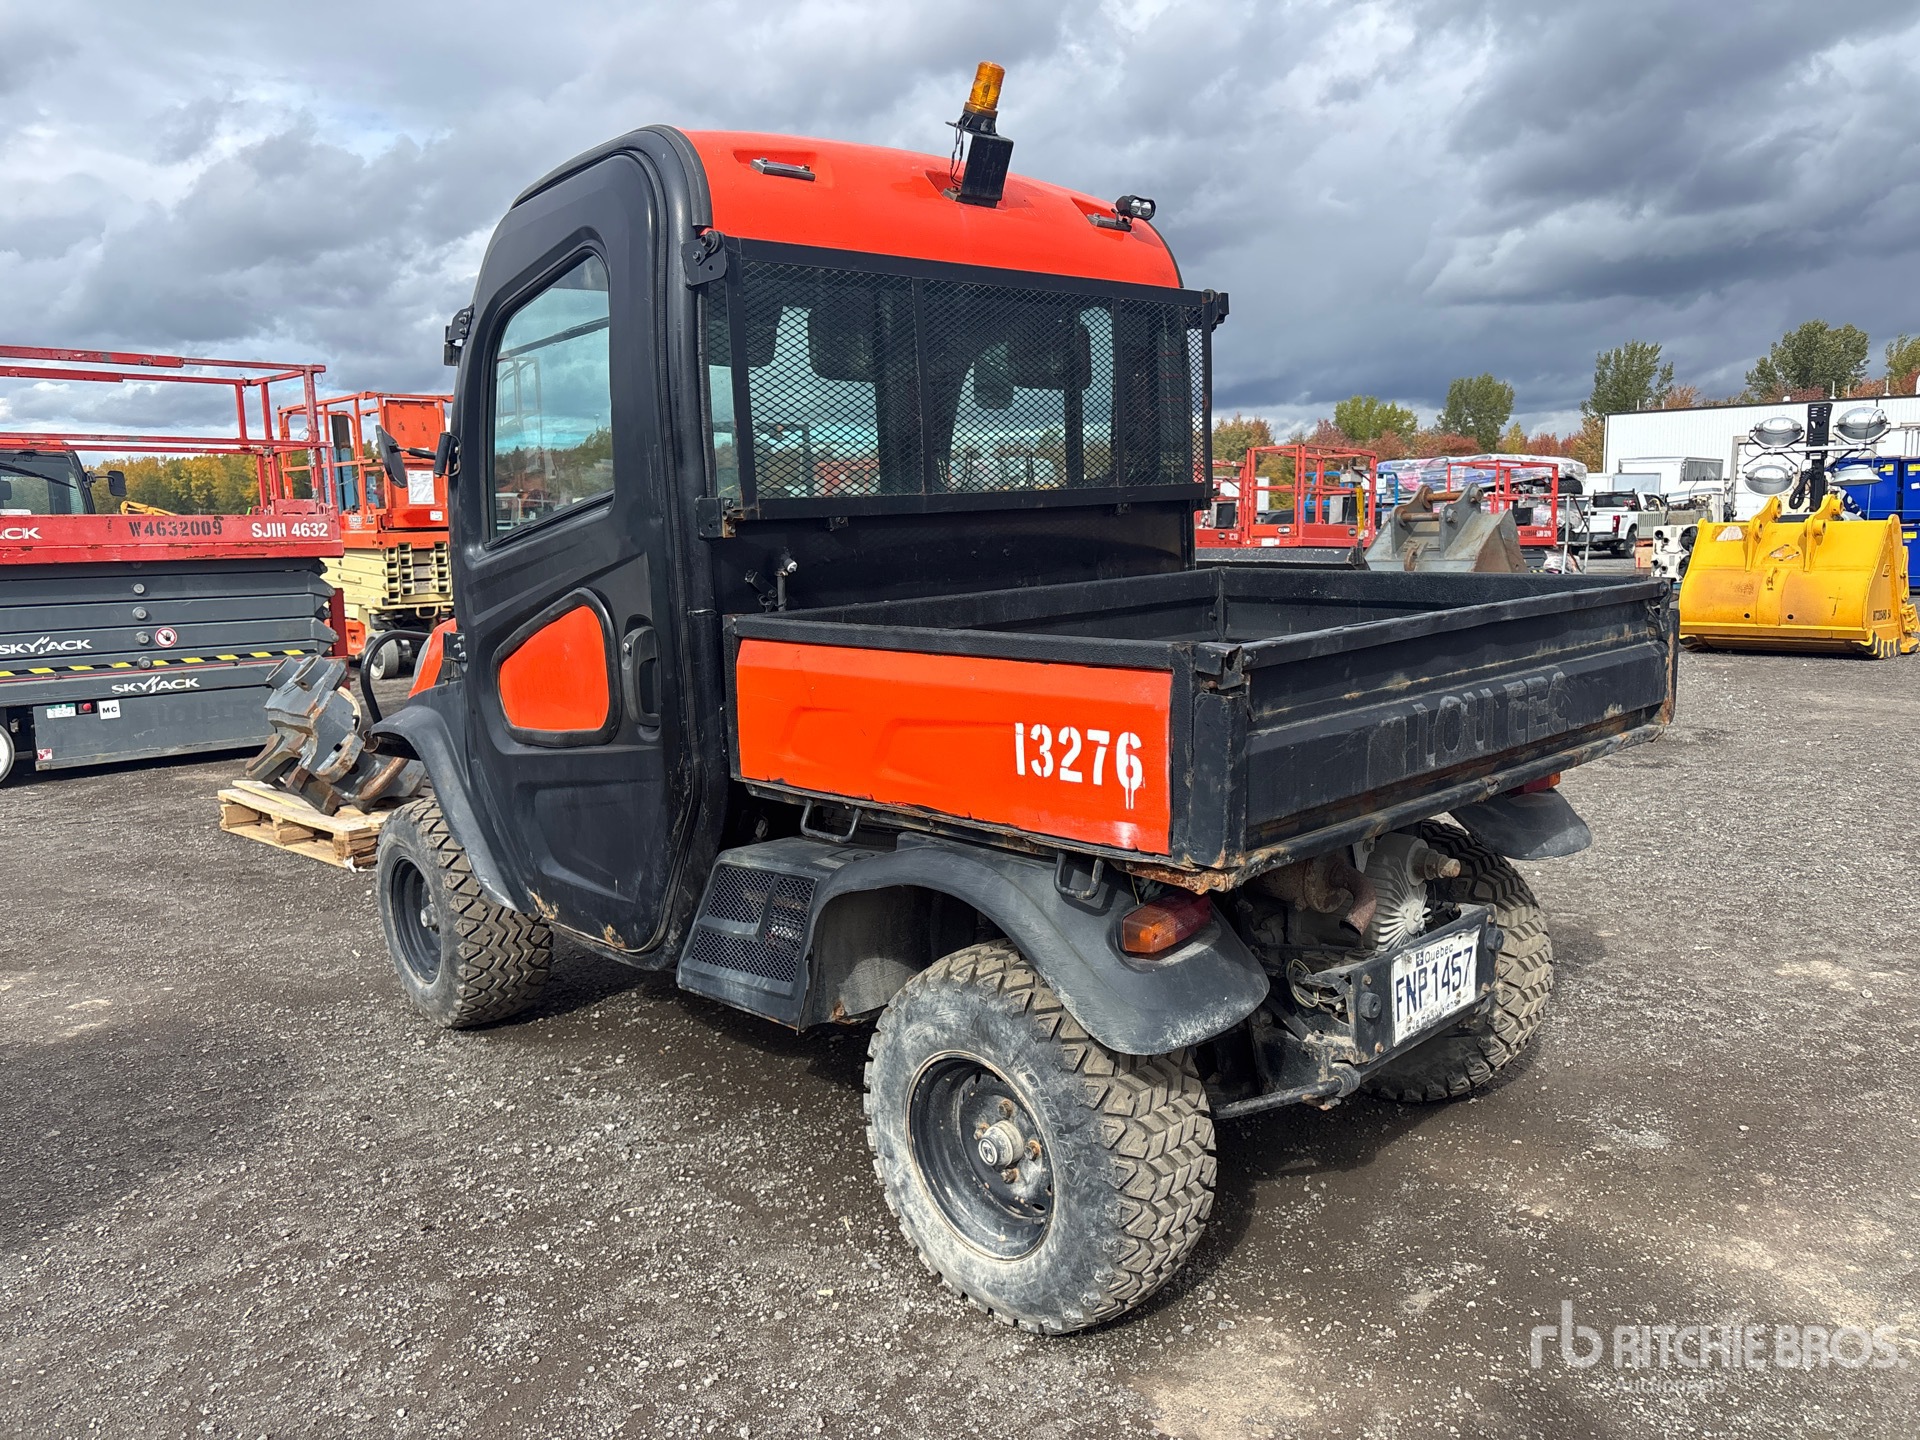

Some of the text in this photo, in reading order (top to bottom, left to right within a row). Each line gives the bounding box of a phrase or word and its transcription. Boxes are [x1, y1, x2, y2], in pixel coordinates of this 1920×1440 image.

[128, 520, 222, 537] W4632009
[291, 522, 329, 537] 4632
[0, 635, 93, 655] SKYJACK
[111, 675, 200, 694] SKYJACK
[1014, 722, 1144, 803] 13276
[1424, 943, 1454, 964] Québec
